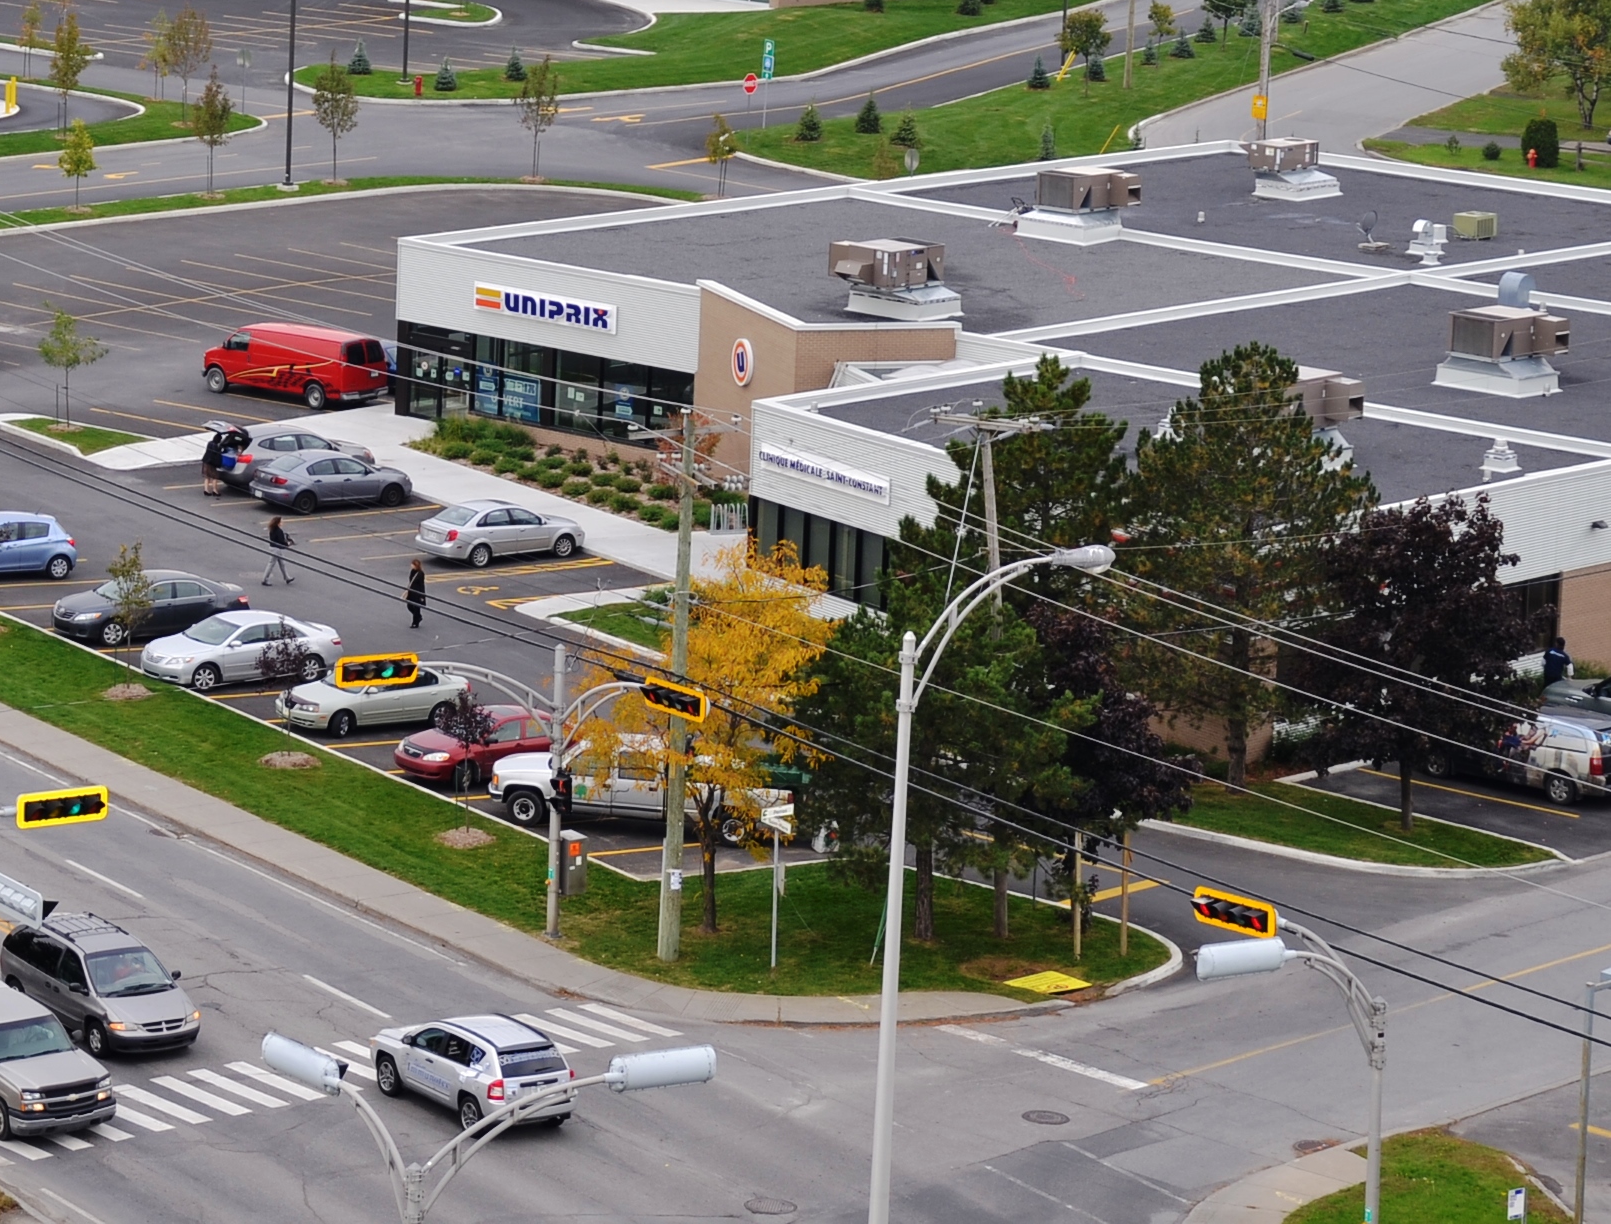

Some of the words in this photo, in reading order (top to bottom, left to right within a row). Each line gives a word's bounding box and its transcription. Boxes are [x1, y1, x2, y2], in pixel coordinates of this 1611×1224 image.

[765, 41, 773, 54] P
[759, 450, 788, 468] CLINIQUE
[790, 459, 822, 478] MÉDICALE
[826, 470, 883, 495] SAINT-CONSTANT
